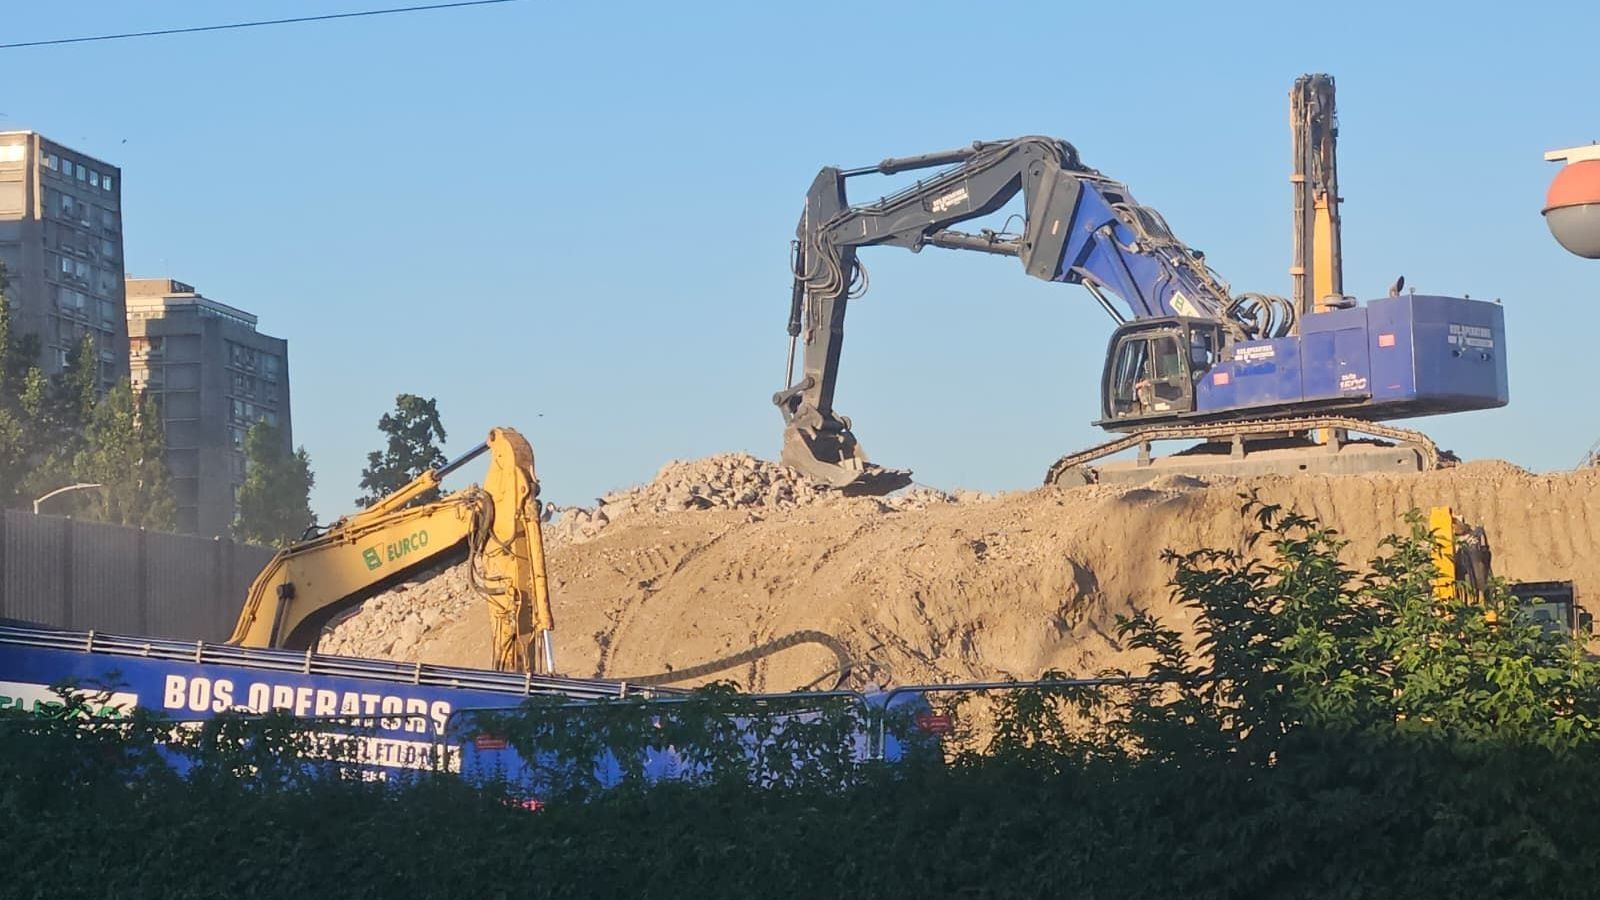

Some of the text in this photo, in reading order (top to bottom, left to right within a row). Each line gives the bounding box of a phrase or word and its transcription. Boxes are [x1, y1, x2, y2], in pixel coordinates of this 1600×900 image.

[386, 529, 428, 561] EURCO
[163, 674, 234, 714] BOS
[247, 681, 451, 736] OPERATORS
